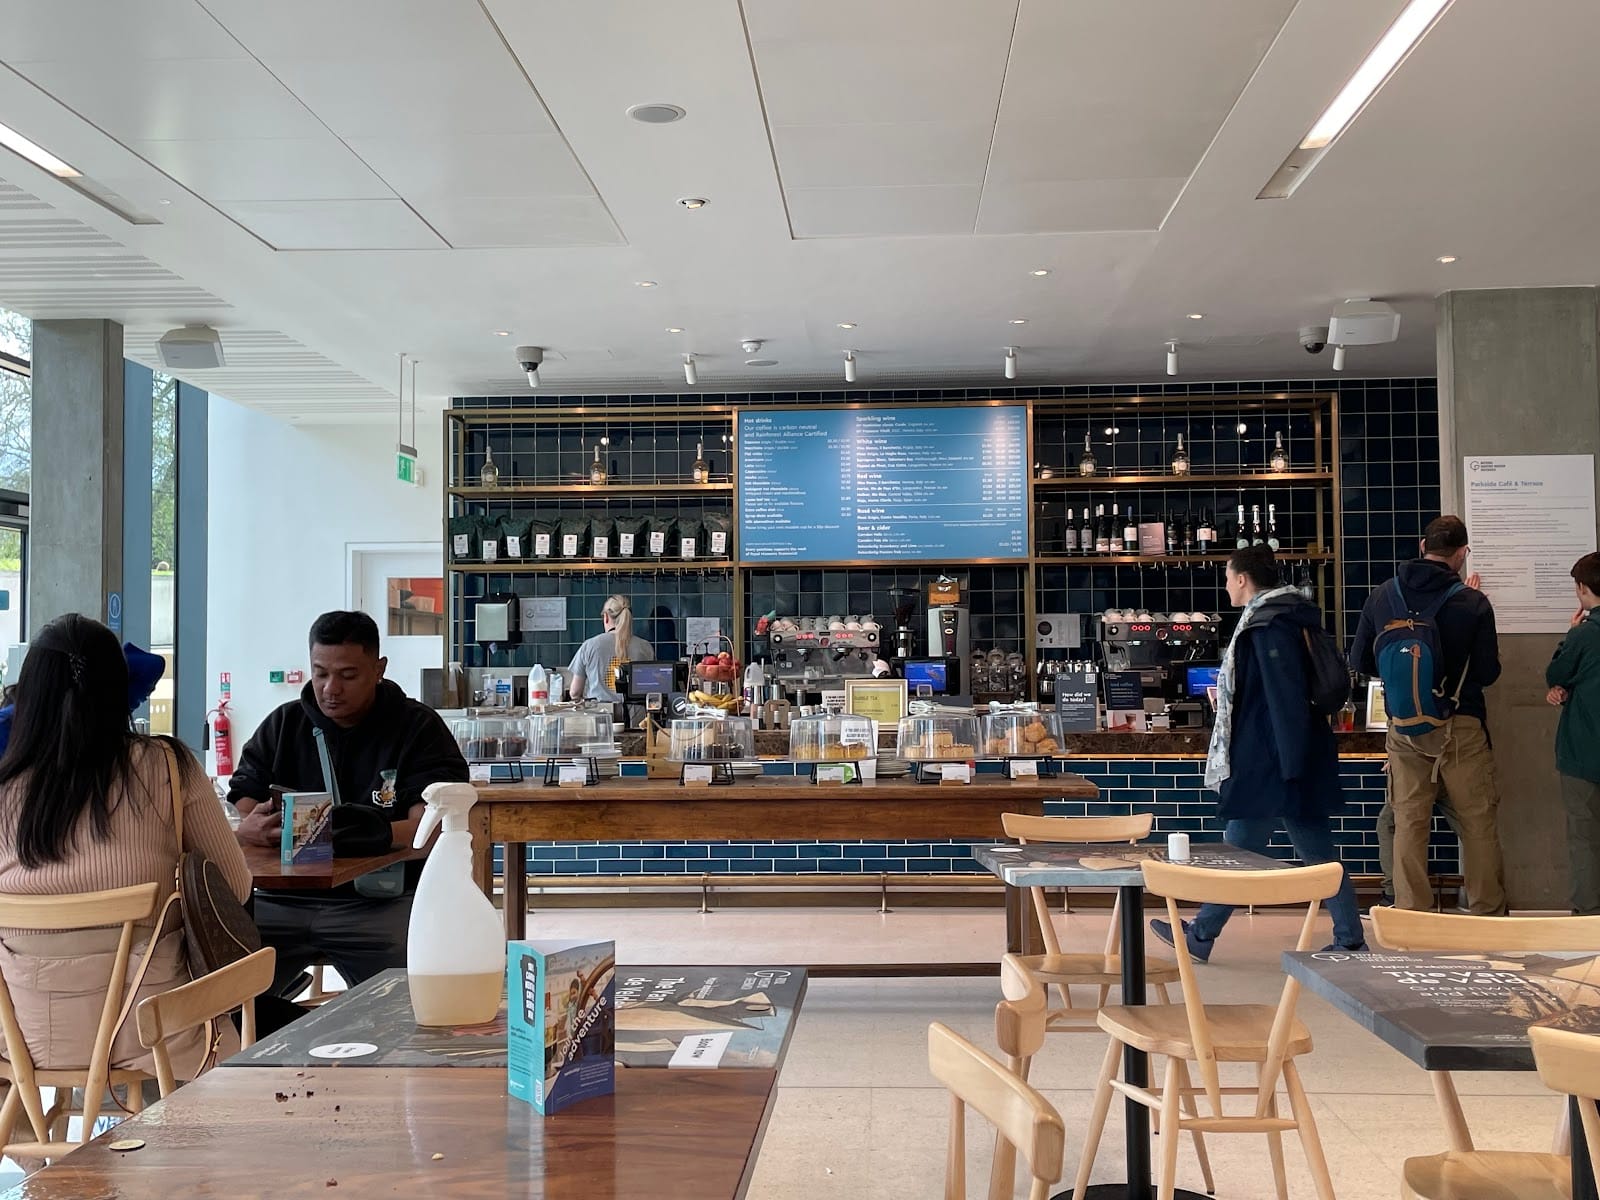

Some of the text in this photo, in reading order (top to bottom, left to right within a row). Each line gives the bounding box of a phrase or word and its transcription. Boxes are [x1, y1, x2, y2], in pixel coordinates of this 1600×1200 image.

[624, 977, 653, 986] de
[645, 977, 686, 1002] The Van
[568, 996, 607, 1061] adventure
[571, 1009, 586, 1031] the
[692, 1038, 714, 1059] Book now
